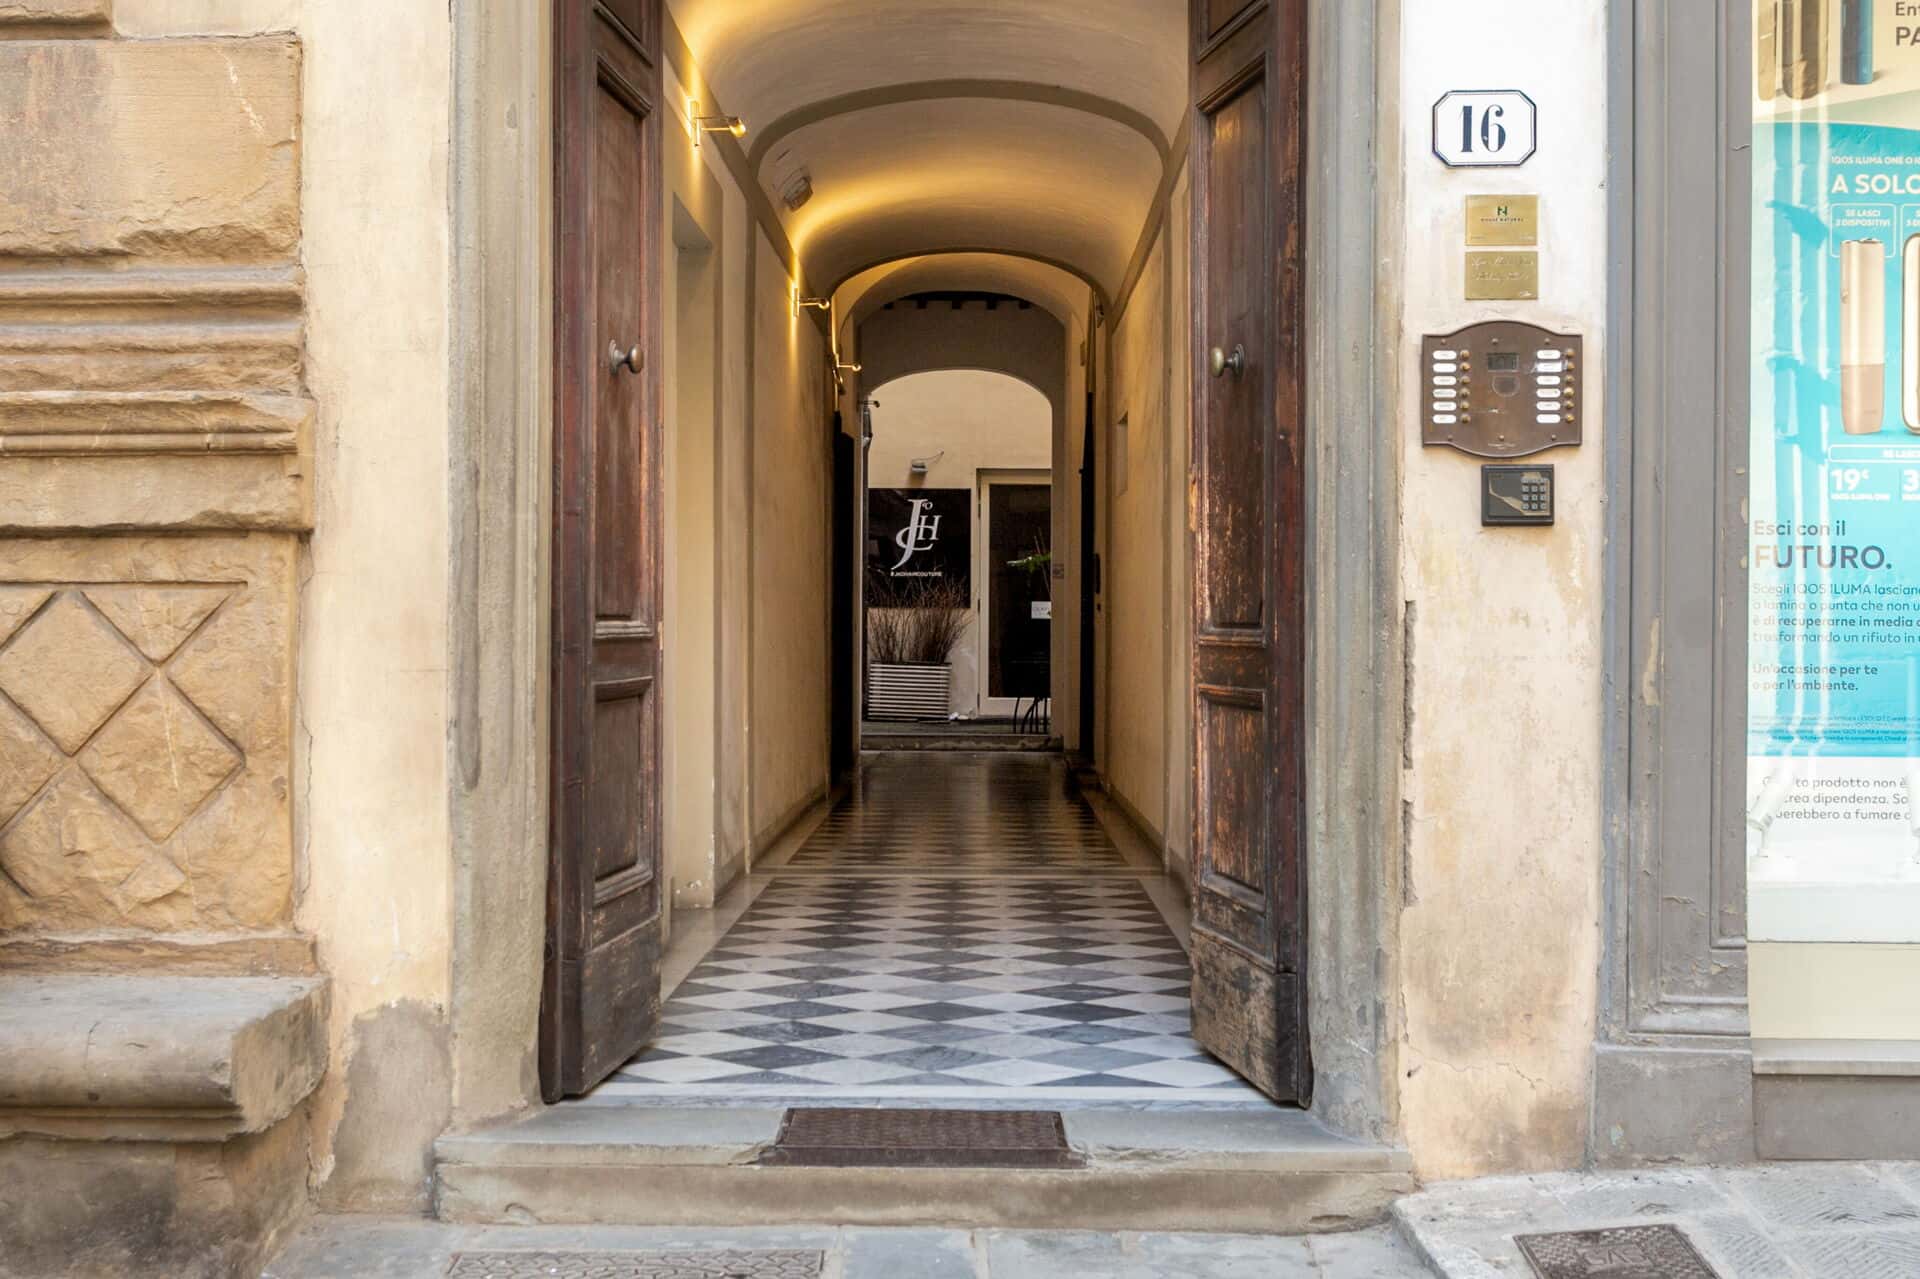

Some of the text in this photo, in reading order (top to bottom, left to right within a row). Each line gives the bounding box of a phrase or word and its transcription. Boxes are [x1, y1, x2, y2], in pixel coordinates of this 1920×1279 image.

[1895, 1, 1920, 16] En
[1457, 104, 1507, 153] 16
[1831, 173, 1849, 194] A
[1754, 520, 1846, 536] Esci con il
[1755, 545, 1893, 569] FUTURO.
[1753, 583, 1790, 597] Scegli
[1830, 583, 1871, 595] ILUMA
[1874, 583, 1920, 595] lascian
[1763, 600, 1805, 611] lamina
[1808, 602, 1818, 610] o
[1820, 601, 1858, 614] punta
[1860, 600, 1883, 611] che
[1886, 602, 1910, 611] non
[1777, 616, 1856, 630] recuperarne
[1858, 616, 1870, 627] in
[1873, 616, 1913, 627] media
[1752, 632, 1841, 643] trasformando
[1843, 634, 1859, 643] un
[1861, 631, 1902, 643] rifiuto
[1904, 631, 1916, 643] in
[1752, 663, 1879, 677] Un'occasione per te
[1763, 682, 1785, 693] per
[1787, 679, 1859, 691] l'ambiente.
[1812, 776, 1871, 790] prodotto
[1873, 779, 1897, 788] non
[1784, 794, 1810, 804] rea
[1812, 792, 1889, 807] dipendenza.
[1842, 811, 1851, 820] a
[1855, 808, 1901, 820] fumare
